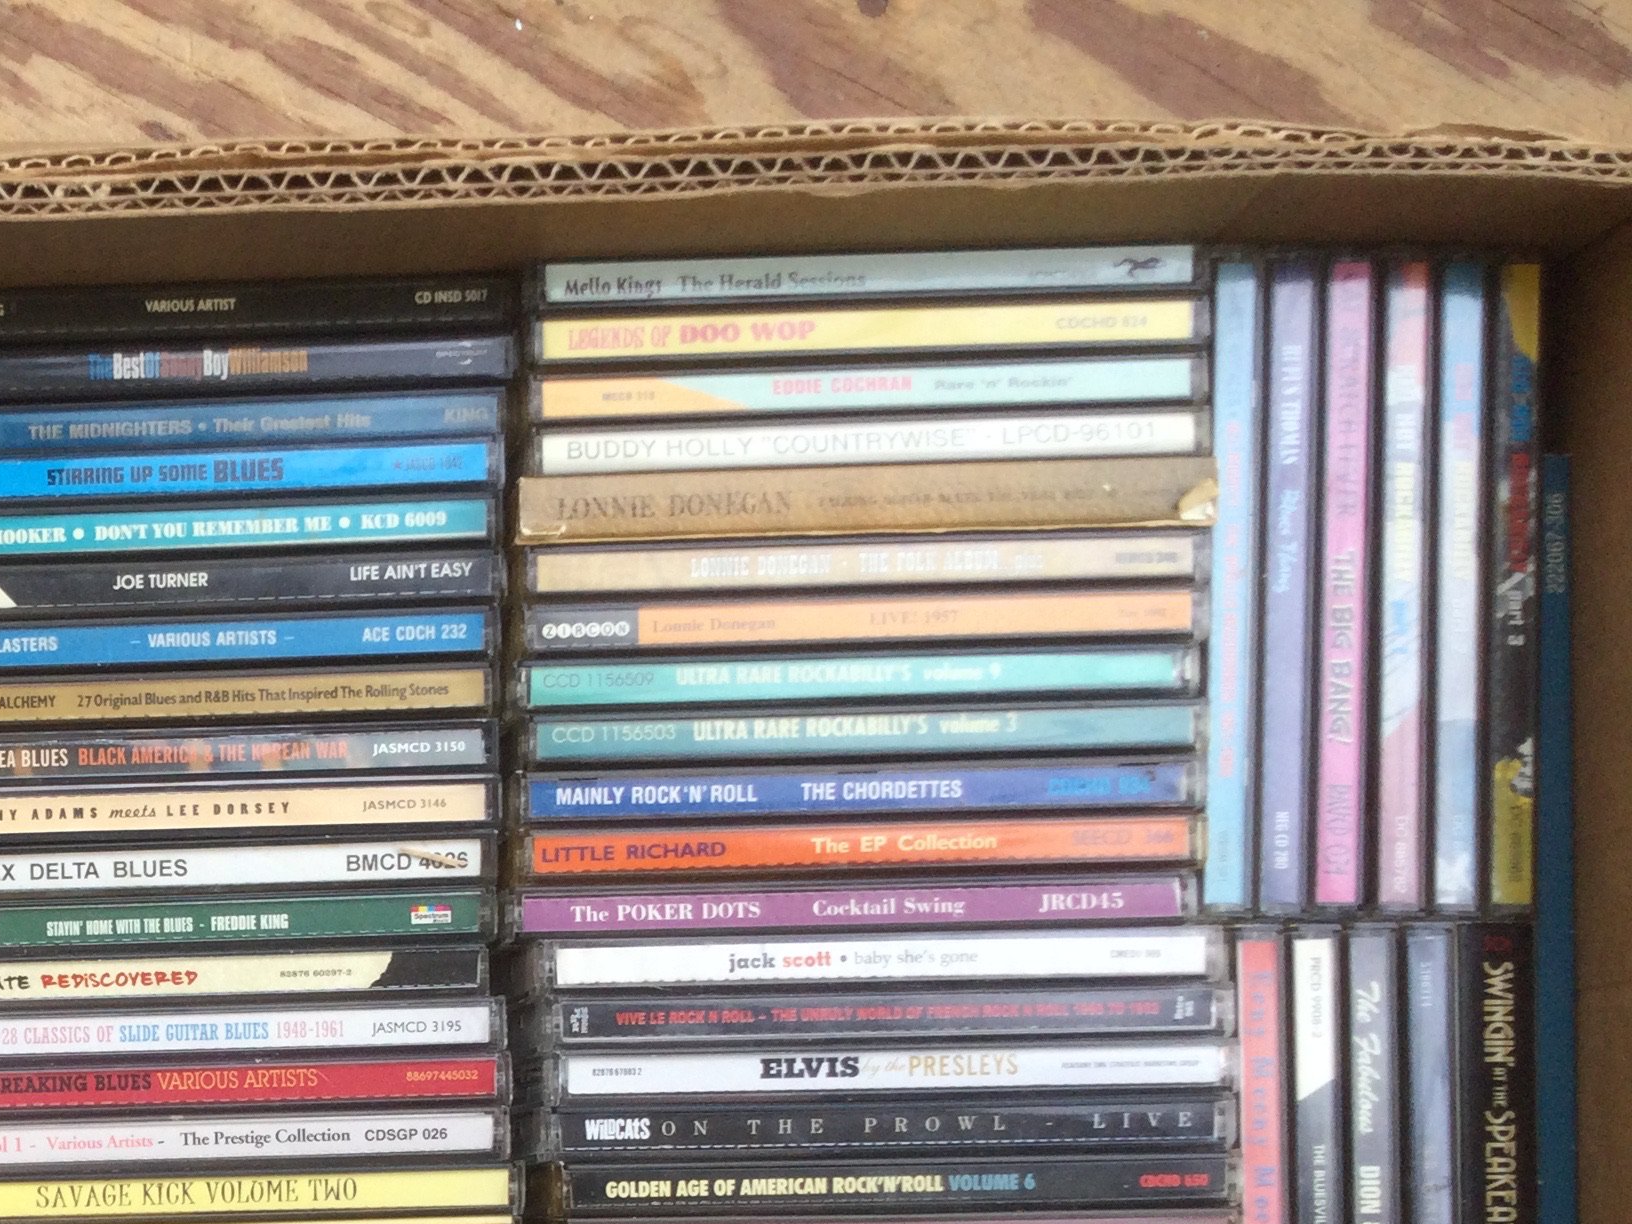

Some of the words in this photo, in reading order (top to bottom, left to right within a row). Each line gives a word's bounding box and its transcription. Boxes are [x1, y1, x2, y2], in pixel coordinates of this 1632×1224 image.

[95, 524, 148, 540] DON'T
[152, 522, 186, 538] YOU
[193, 518, 298, 536] REMEMBER
[304, 516, 331, 532] ME
[362, 513, 399, 529] KCD
[405, 511, 447, 527] 6009
[801, 782, 836, 800] THE
[843, 780, 962, 800] CHORDETTES
[542, 845, 614, 863] LITTLE
[627, 842, 726, 859] RICHARD
[810, 835, 849, 853] The
[860, 833, 887, 851] EP
[898, 831, 997, 850] Collection
[30, 862, 99, 880] DELTA
[114, 859, 187, 878] BLUES
[570, 906, 609, 922] The
[618, 904, 693, 921] POKER
[703, 902, 760, 919] DOTS
[406, 1070, 478, 1081] 88697445032
[760, 1056, 859, 1078] ELVIS
[909, 1055, 1017, 1076] PRESLEYS
